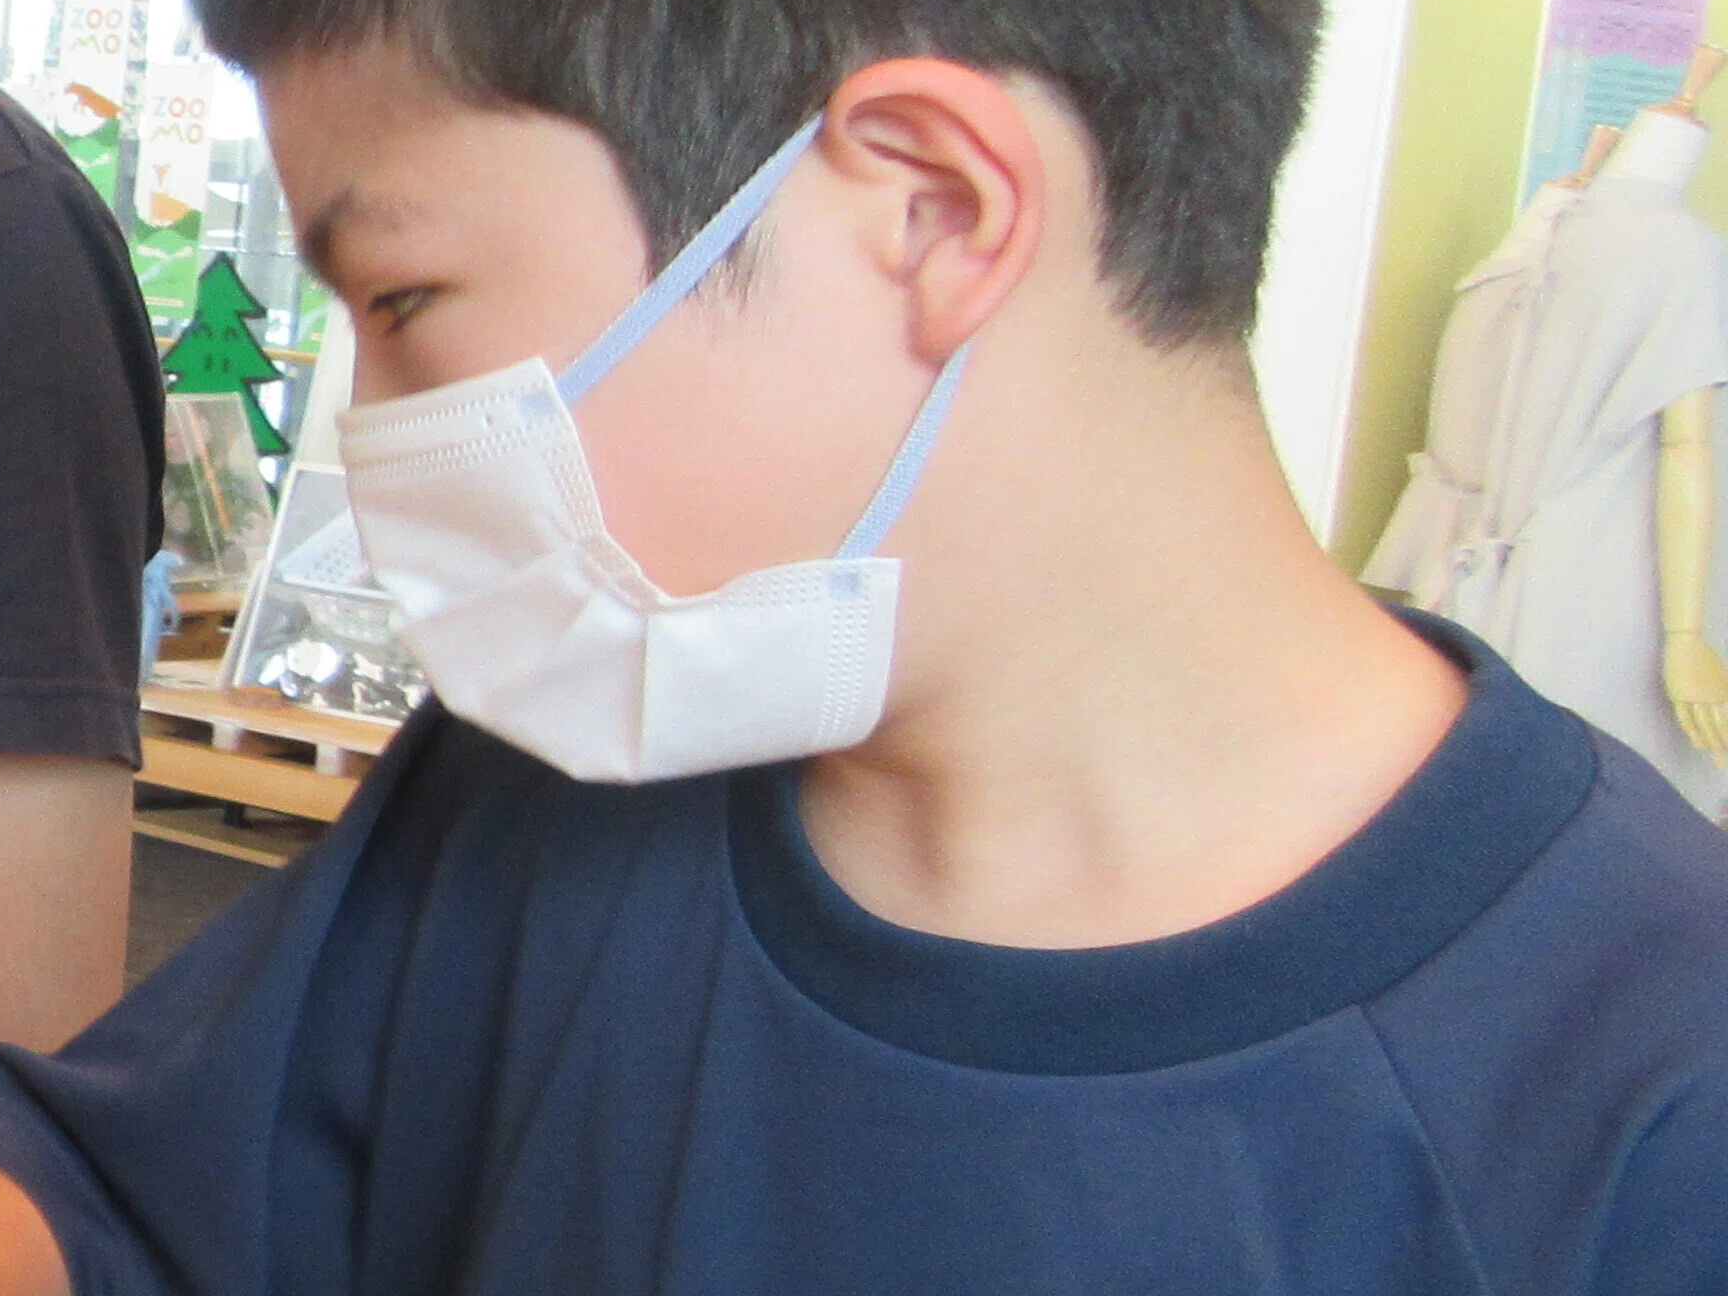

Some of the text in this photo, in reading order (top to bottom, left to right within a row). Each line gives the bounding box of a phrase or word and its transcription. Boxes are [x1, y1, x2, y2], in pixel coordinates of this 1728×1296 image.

[70, 8, 123, 29] ZOO
[69, 33, 122, 54] MO
[152, 95, 207, 119] ZOO
[151, 122, 205, 145] MO
